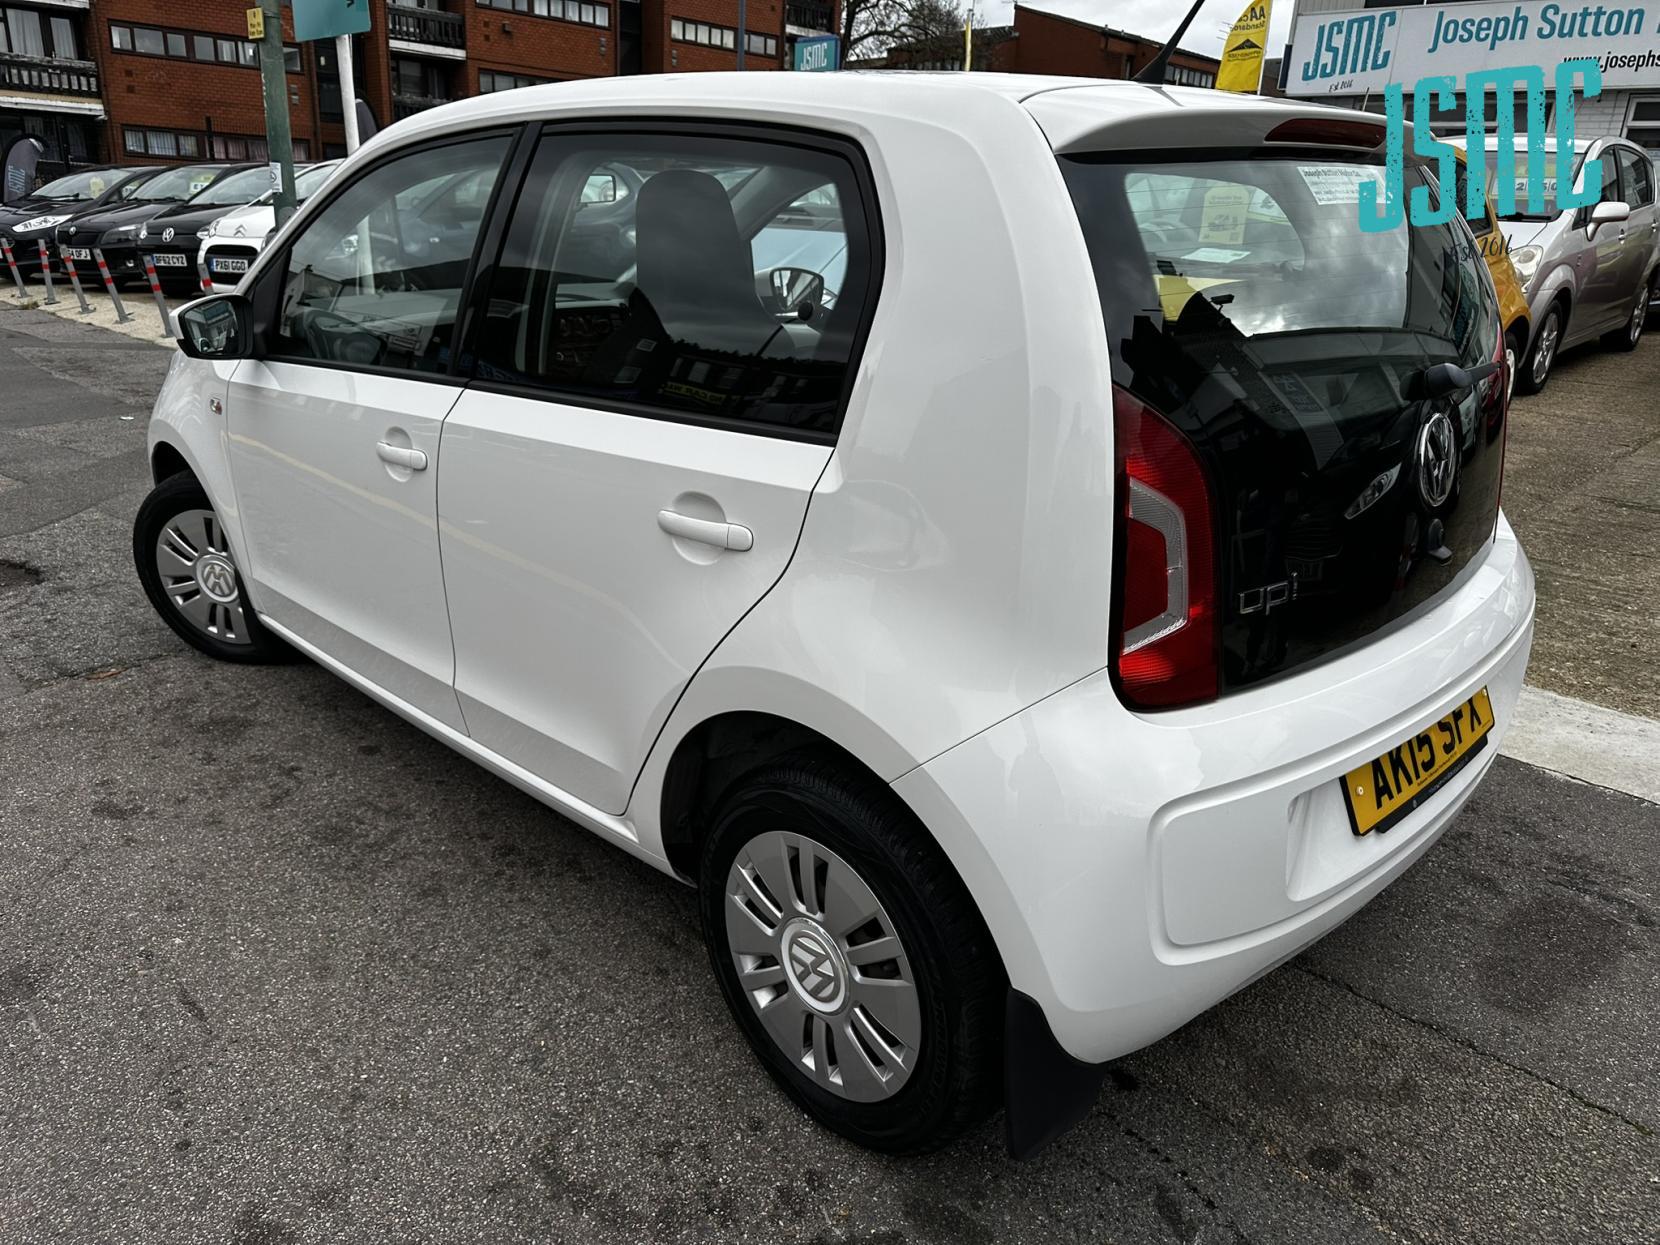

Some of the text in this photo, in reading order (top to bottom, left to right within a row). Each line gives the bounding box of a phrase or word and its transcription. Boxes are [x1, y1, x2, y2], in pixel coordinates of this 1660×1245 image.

[1301, 11, 1396, 81] JSMC
[1427, 3, 1645, 53] Joseph Sutton
[800, 42, 827, 70] JSMC
[215, 260, 230, 270] PX61
[1371, 733, 1436, 810] AK15
[1437, 697, 1482, 755] SFX
